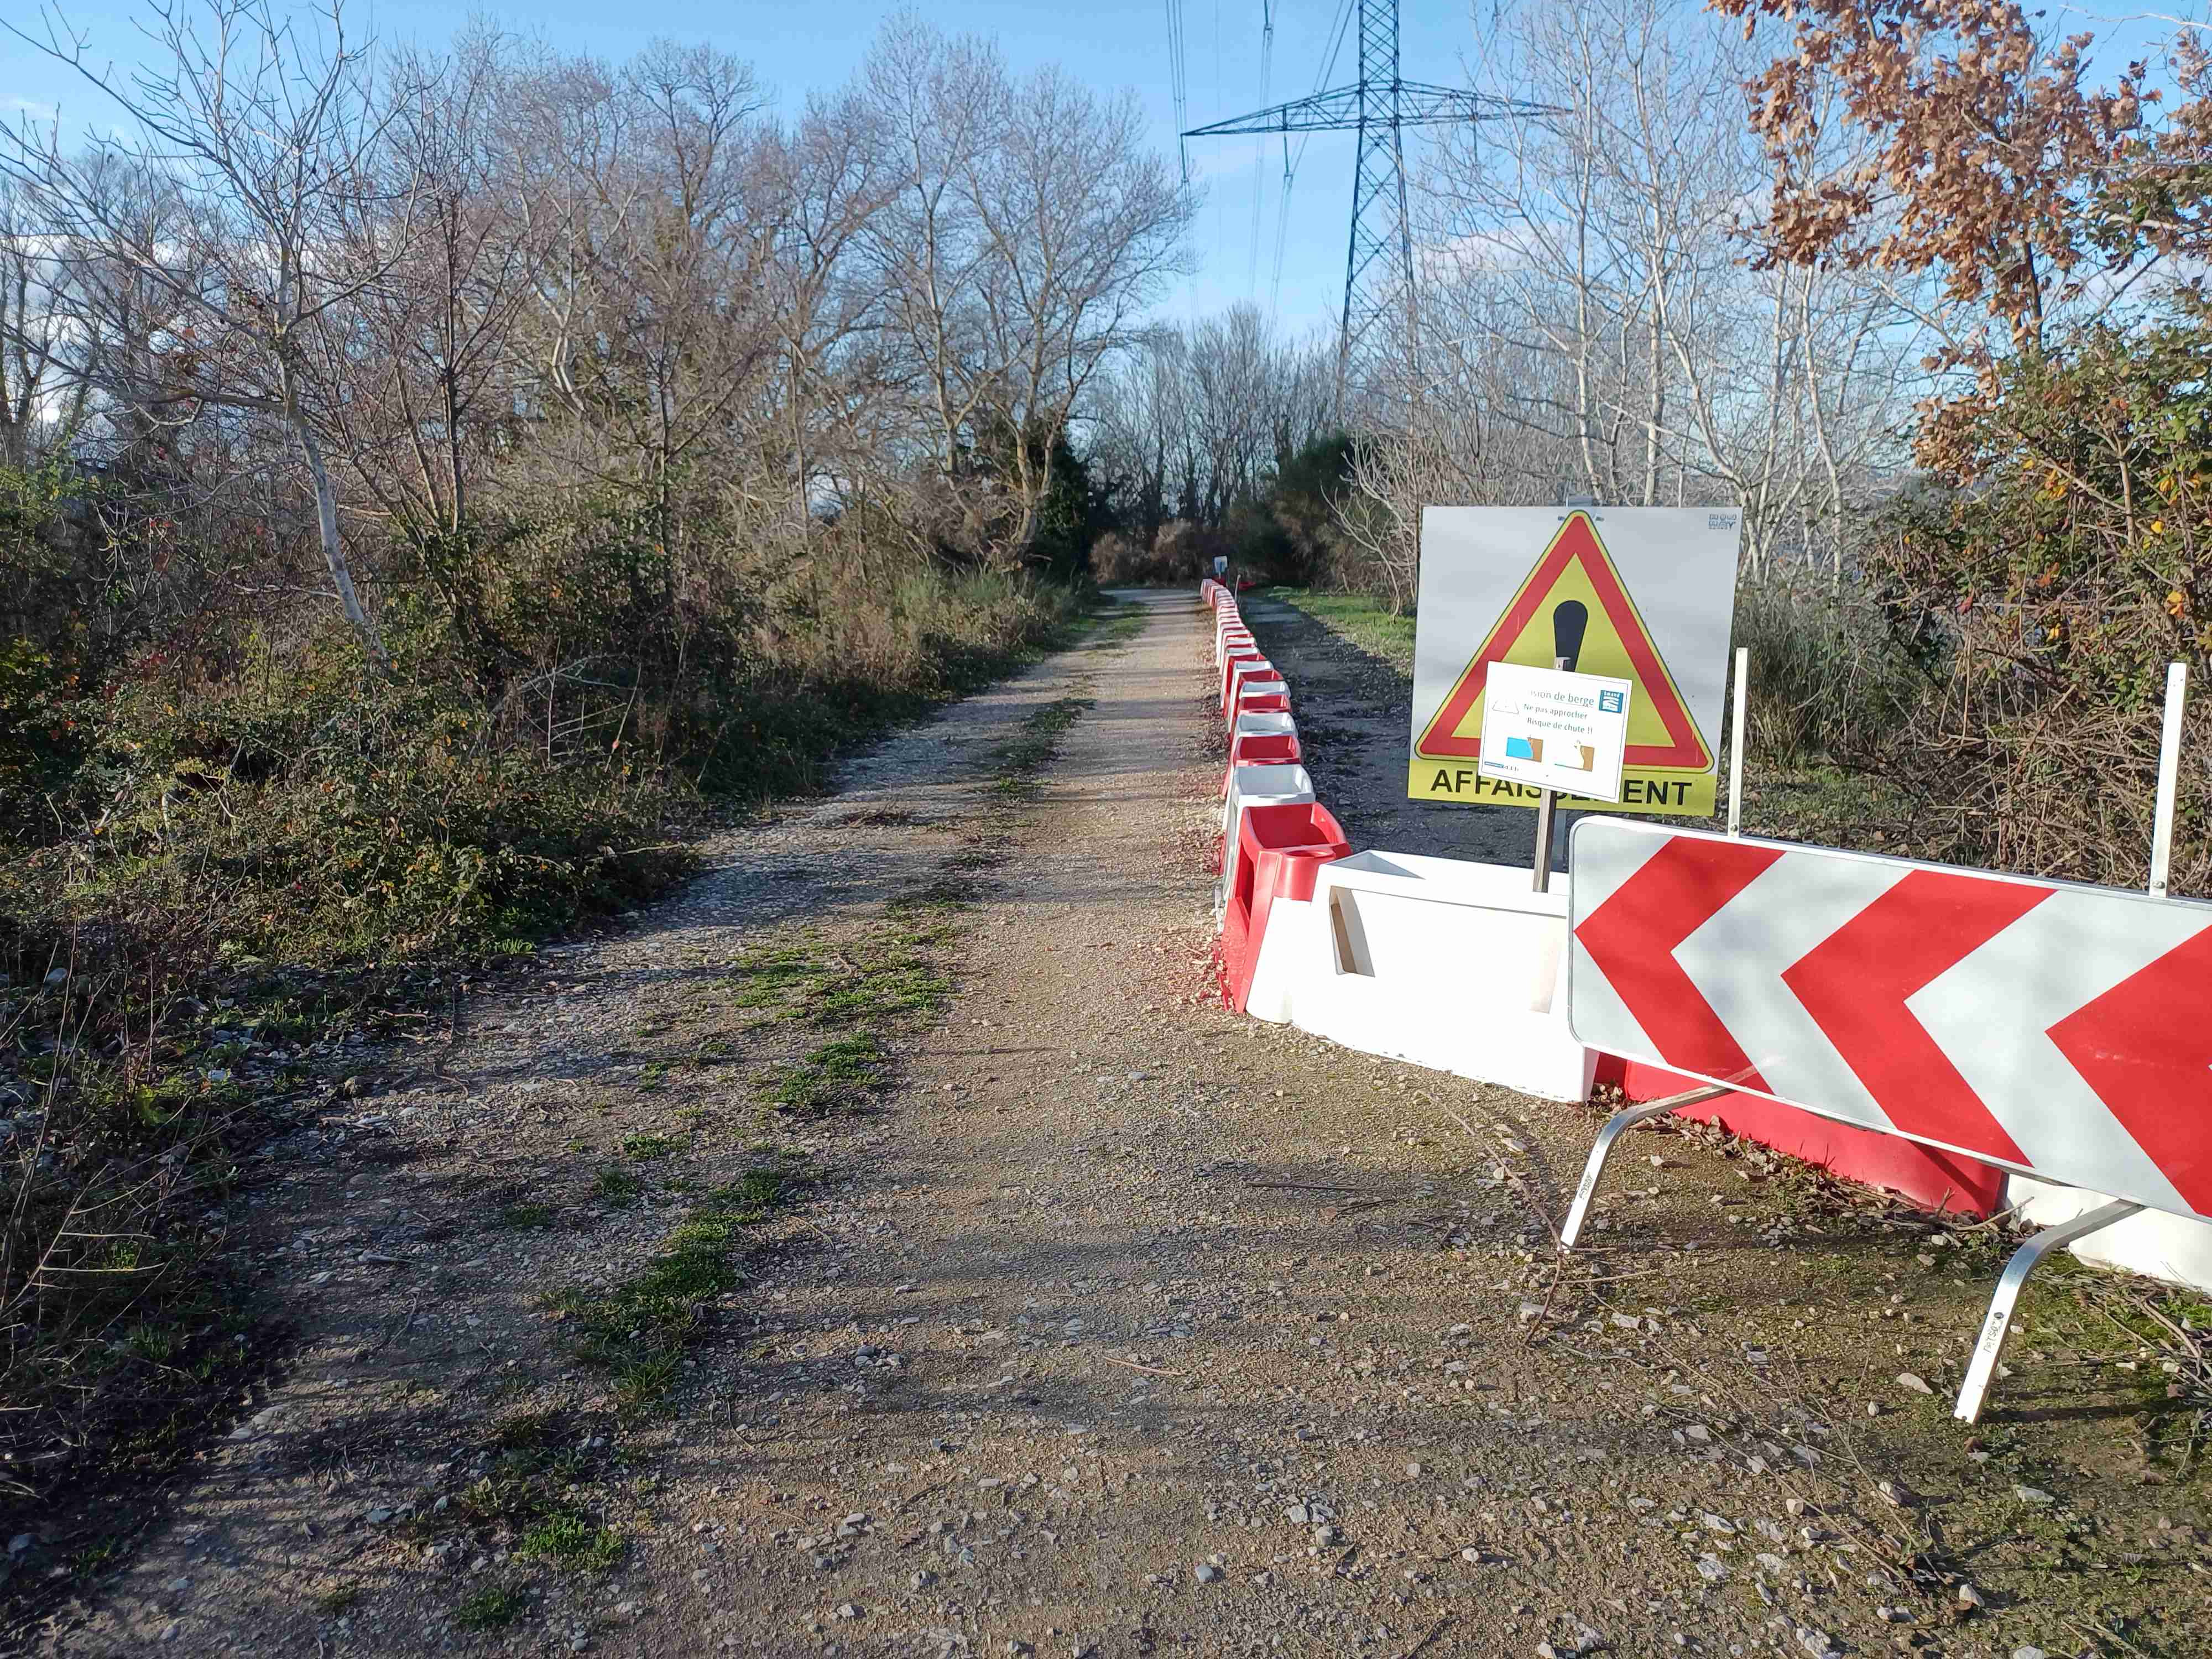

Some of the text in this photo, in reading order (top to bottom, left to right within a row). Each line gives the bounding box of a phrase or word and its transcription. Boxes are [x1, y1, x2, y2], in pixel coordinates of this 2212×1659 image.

[1554, 692, 1566, 701] de
[1568, 693, 1594, 706] berge
[1550, 708, 1588, 719] approcher
[1527, 717, 1551, 728] Risque
[1564, 723, 1585, 733] chute
[1430, 769, 1693, 806] AFFAISENT
